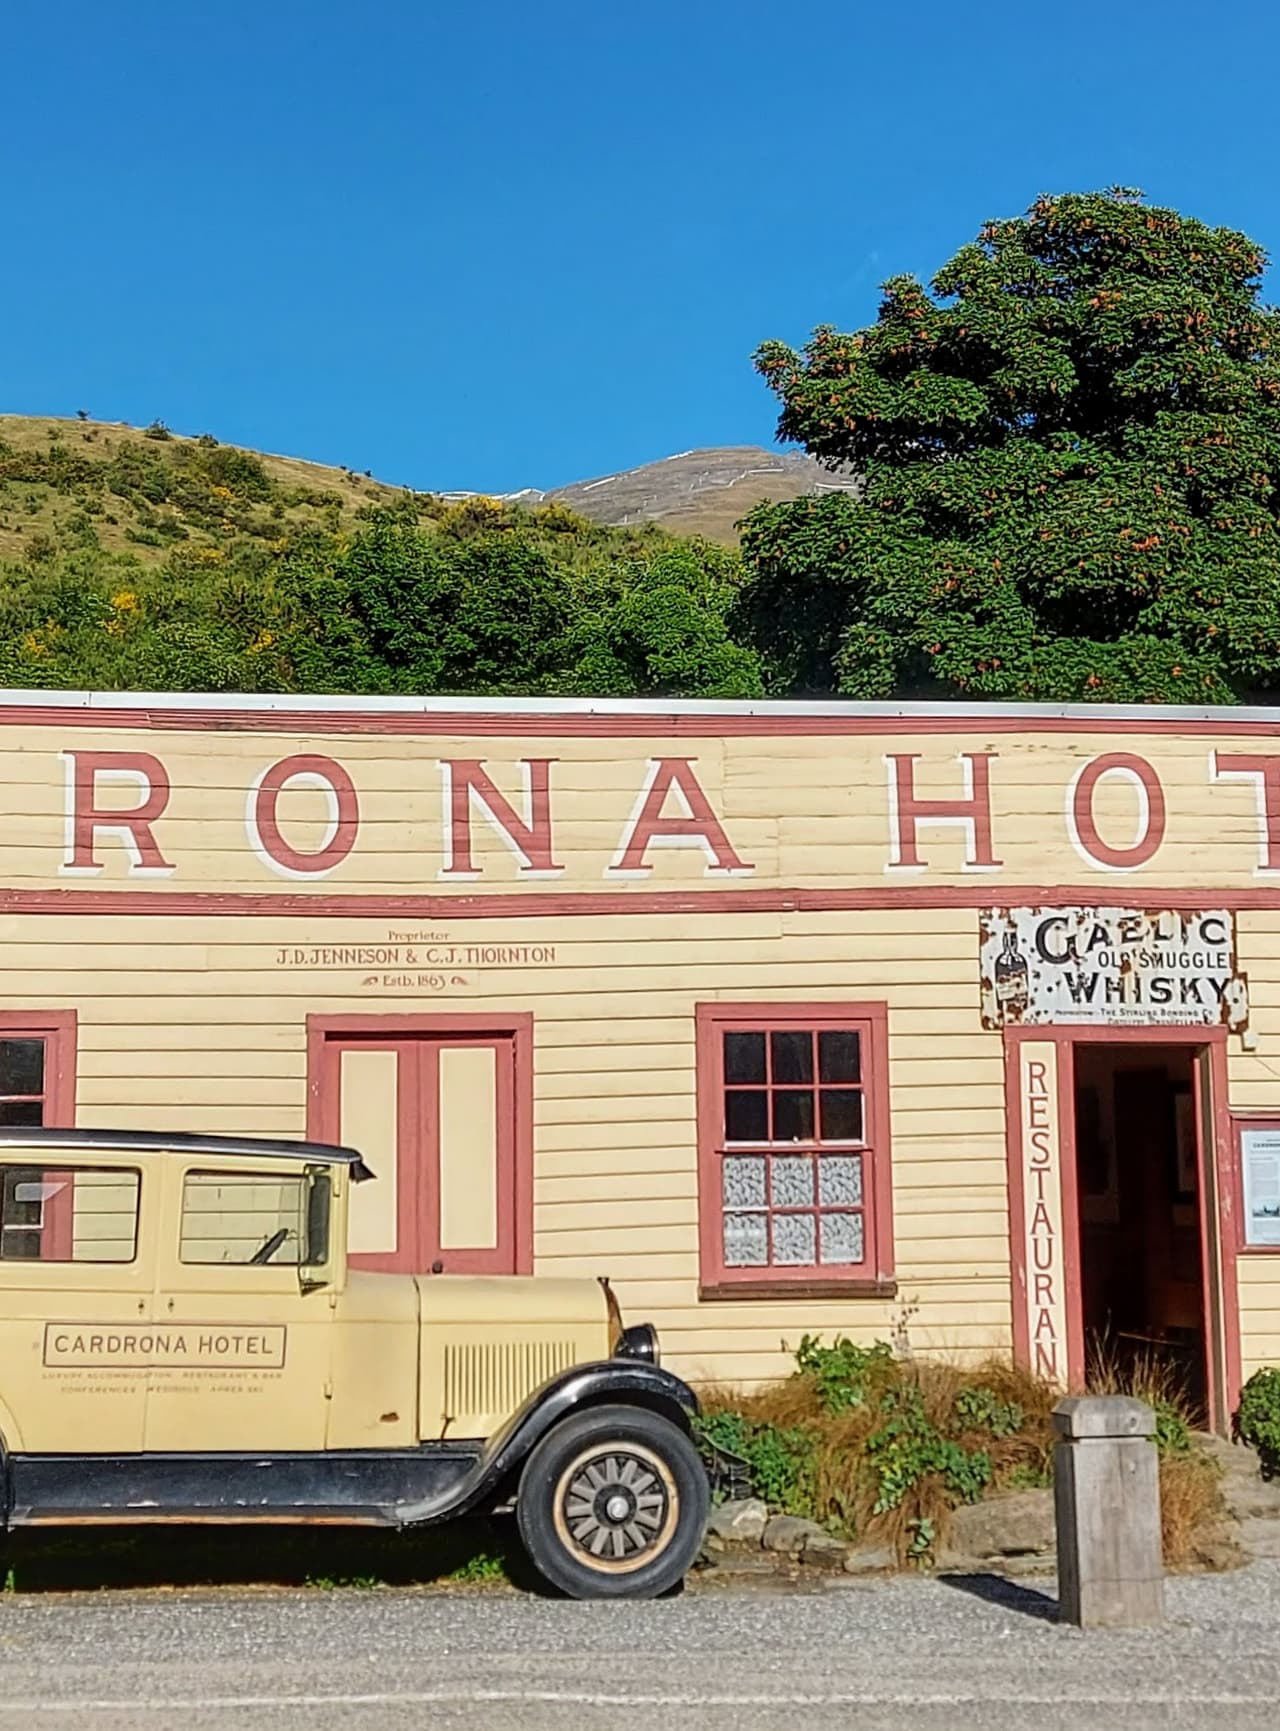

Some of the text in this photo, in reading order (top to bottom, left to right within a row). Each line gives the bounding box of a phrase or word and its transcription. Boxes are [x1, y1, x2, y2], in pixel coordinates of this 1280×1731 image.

[388, 929, 451, 942] Proprietor
[1035, 915, 1228, 965] GAELIC
[406, 949, 418, 964] &
[467, 947, 557, 964] THORNTON
[1139, 951, 1235, 969] SMUGGLE
[1063, 971, 1234, 1005] WHISKY
[1027, 1060, 1060, 1385] RESTAURAN
[54, 1335, 274, 1354] CARDRONA HOTEL
